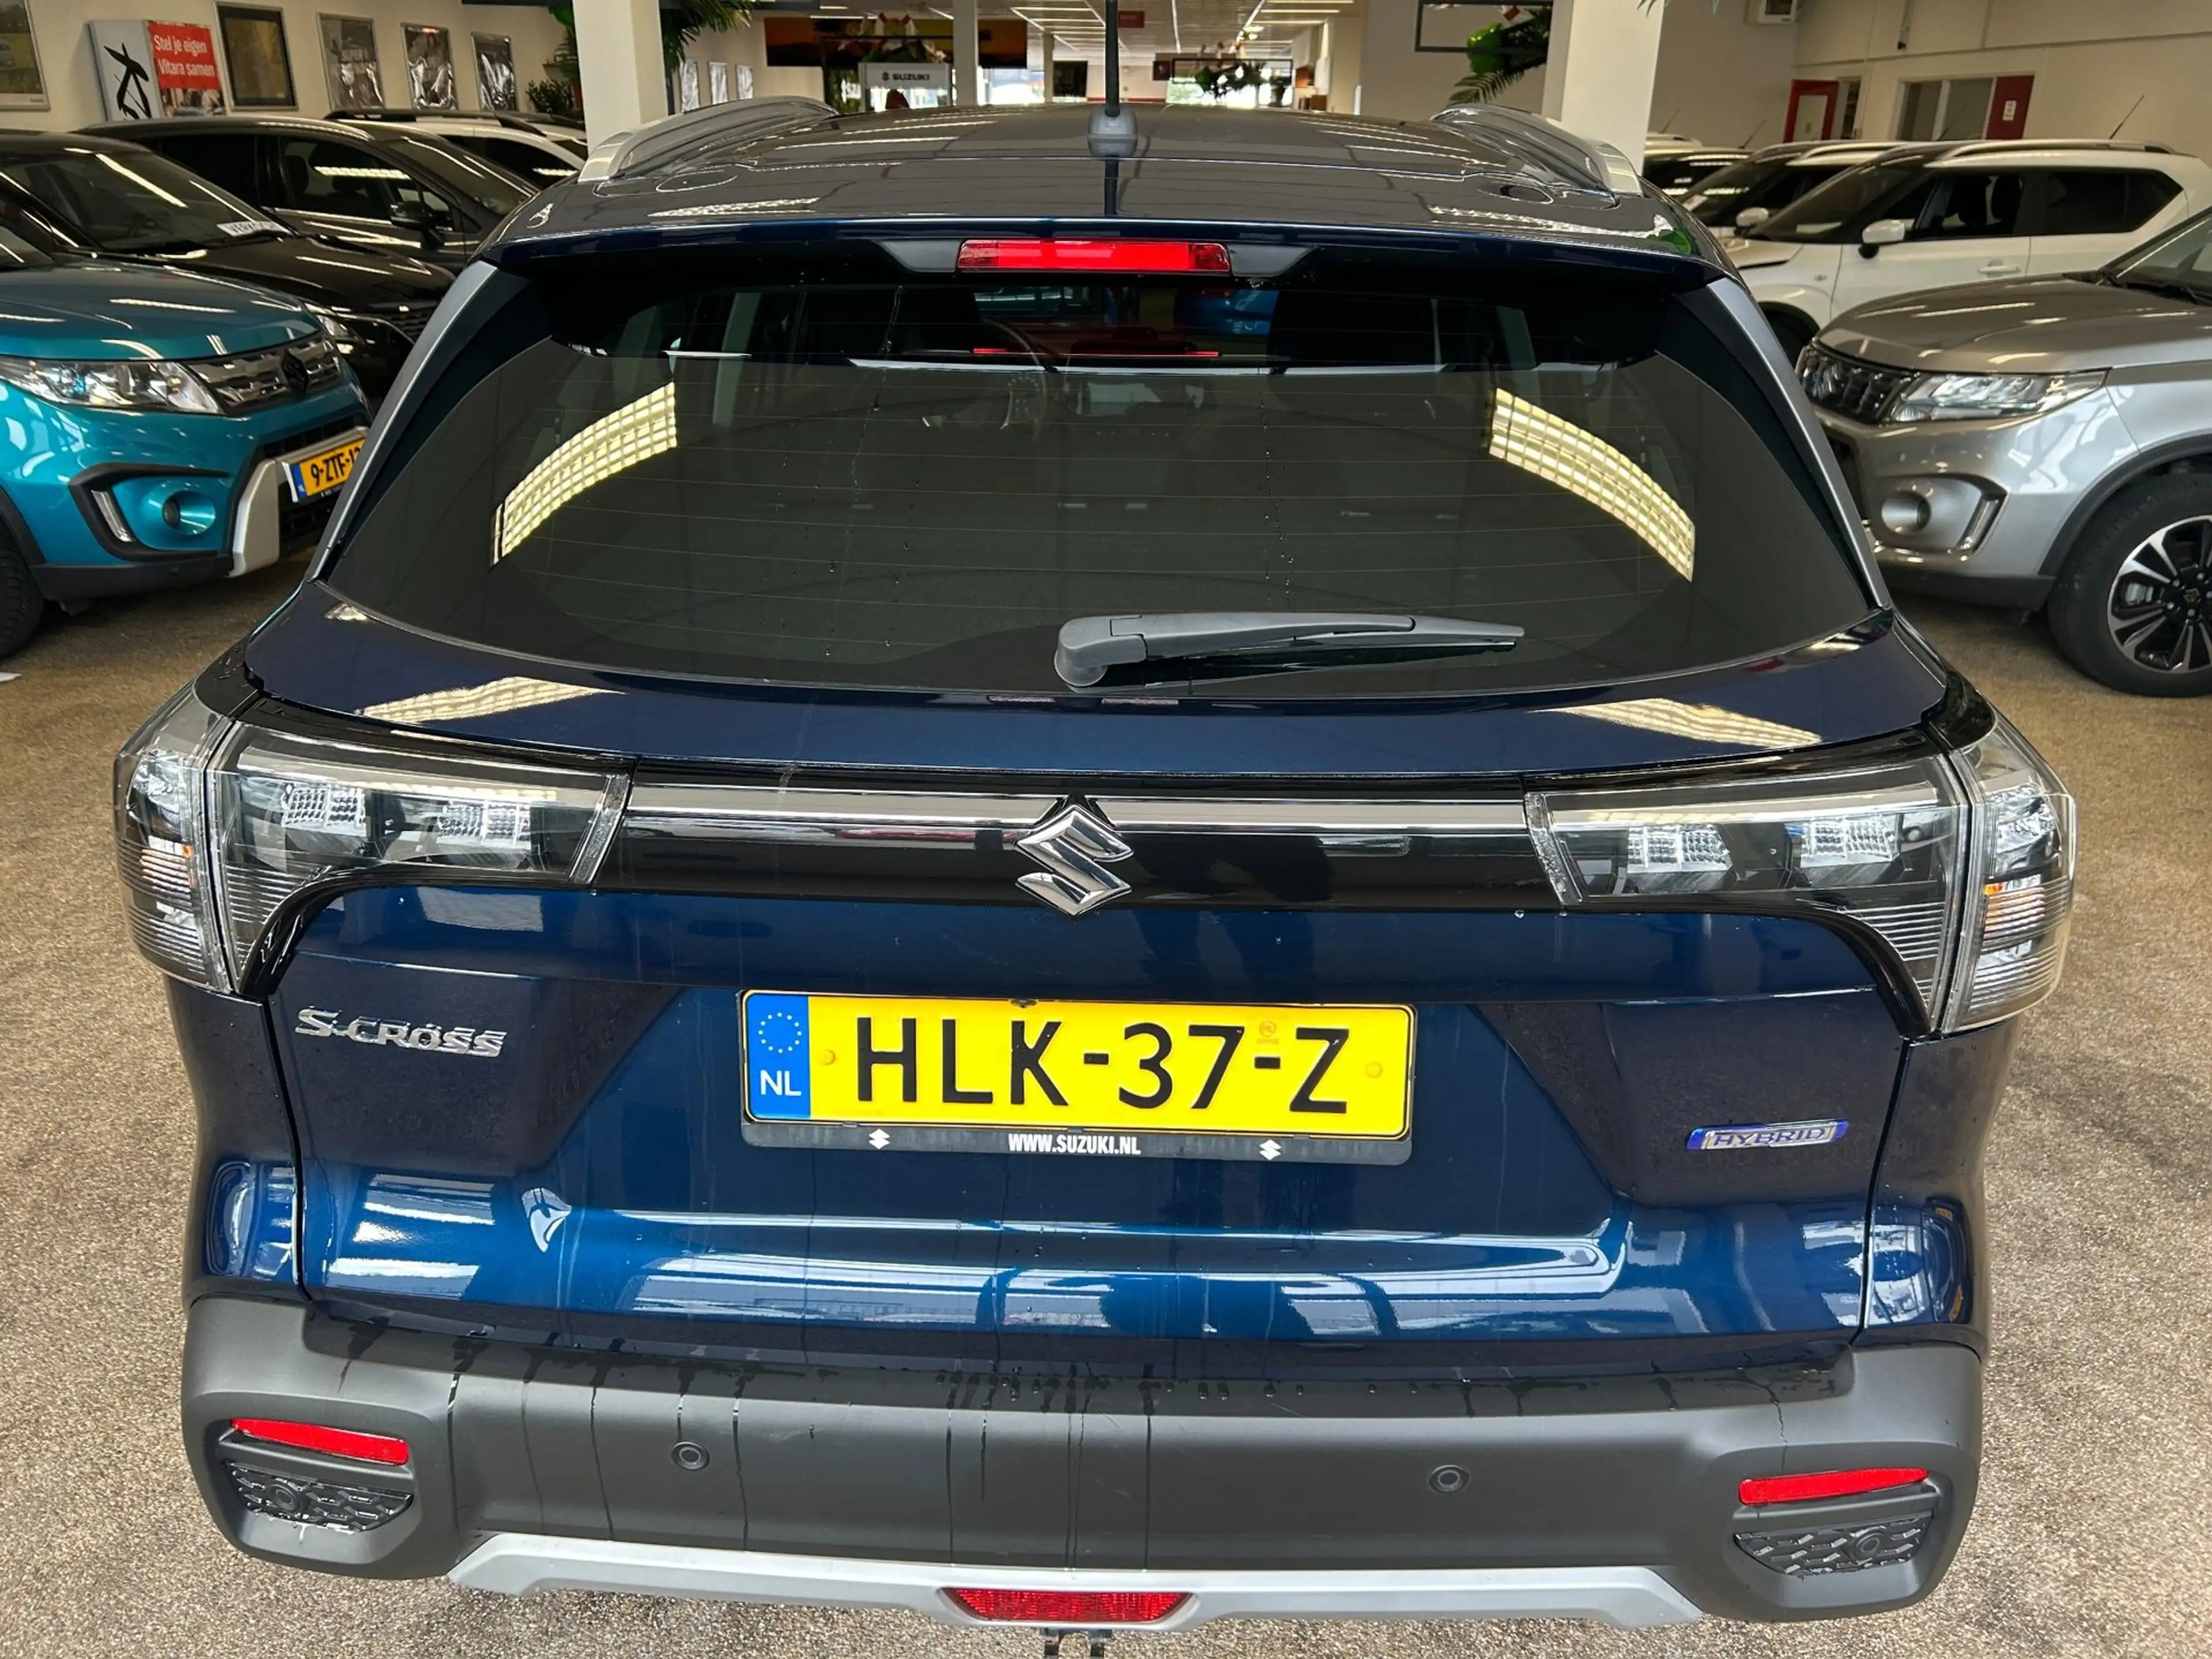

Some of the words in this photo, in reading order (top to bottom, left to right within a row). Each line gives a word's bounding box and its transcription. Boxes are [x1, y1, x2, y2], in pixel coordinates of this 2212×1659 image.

[154, 35, 173, 51] Stel
[173, 36, 183, 55] je
[183, 37, 207, 57] eigen
[158, 58, 185, 75] Vitara
[185, 63, 215, 77] samen
[857, 1017, 1349, 1114] HLK-37-Z
[760, 1069, 802, 1097] NL
[1008, 1132, 1142, 1155] WWW.SUZUKI.NL
[1713, 1127, 1826, 1146] HYBRID
